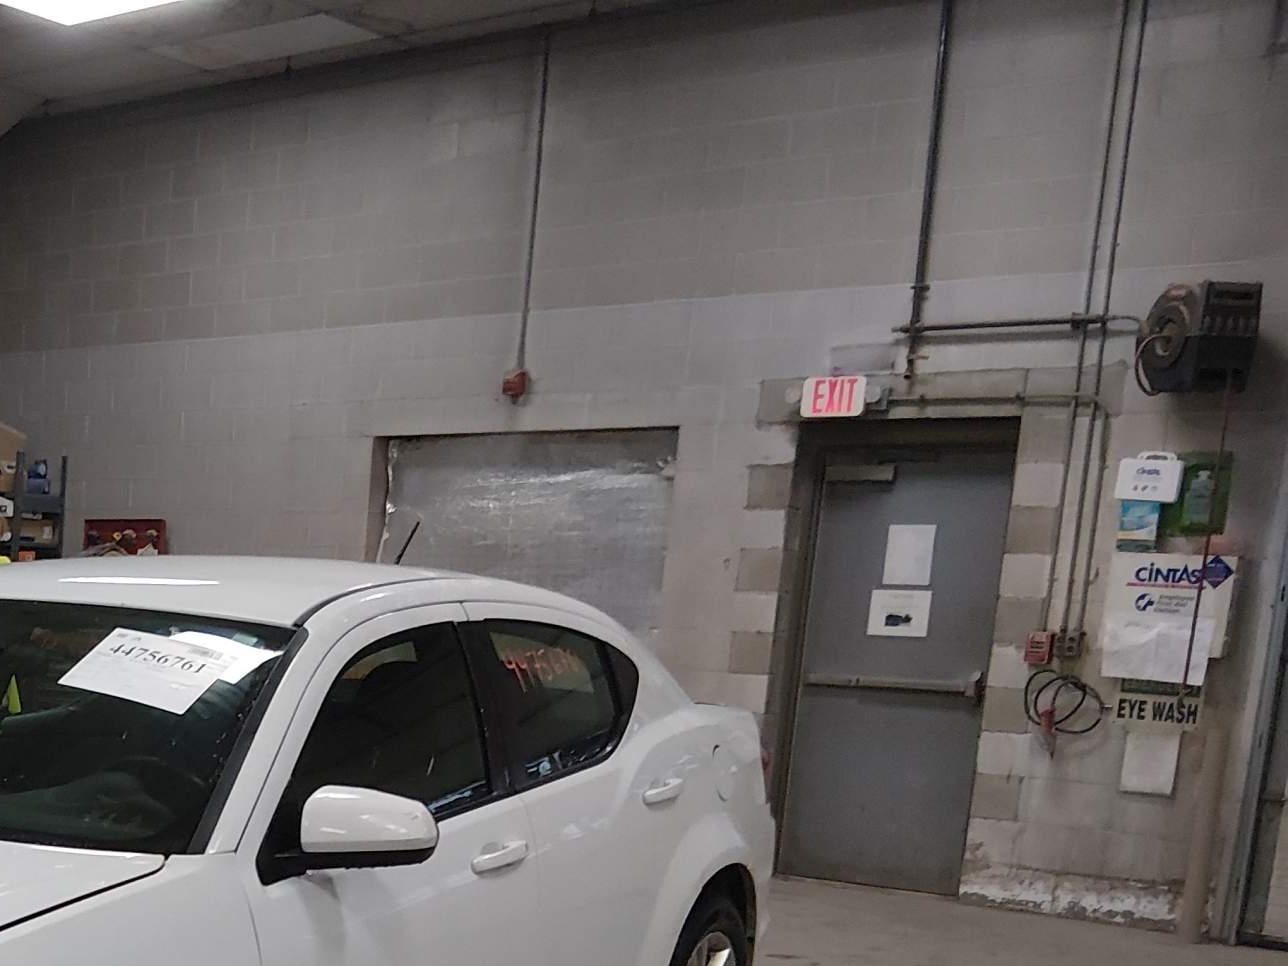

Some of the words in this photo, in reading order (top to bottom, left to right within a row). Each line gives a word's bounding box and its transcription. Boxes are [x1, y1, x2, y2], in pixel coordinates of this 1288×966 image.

[811, 377, 858, 414] EXIT
[111, 643, 207, 674] 44756761
[1116, 698, 1147, 720] EYE
[1152, 701, 1199, 725] WASH
